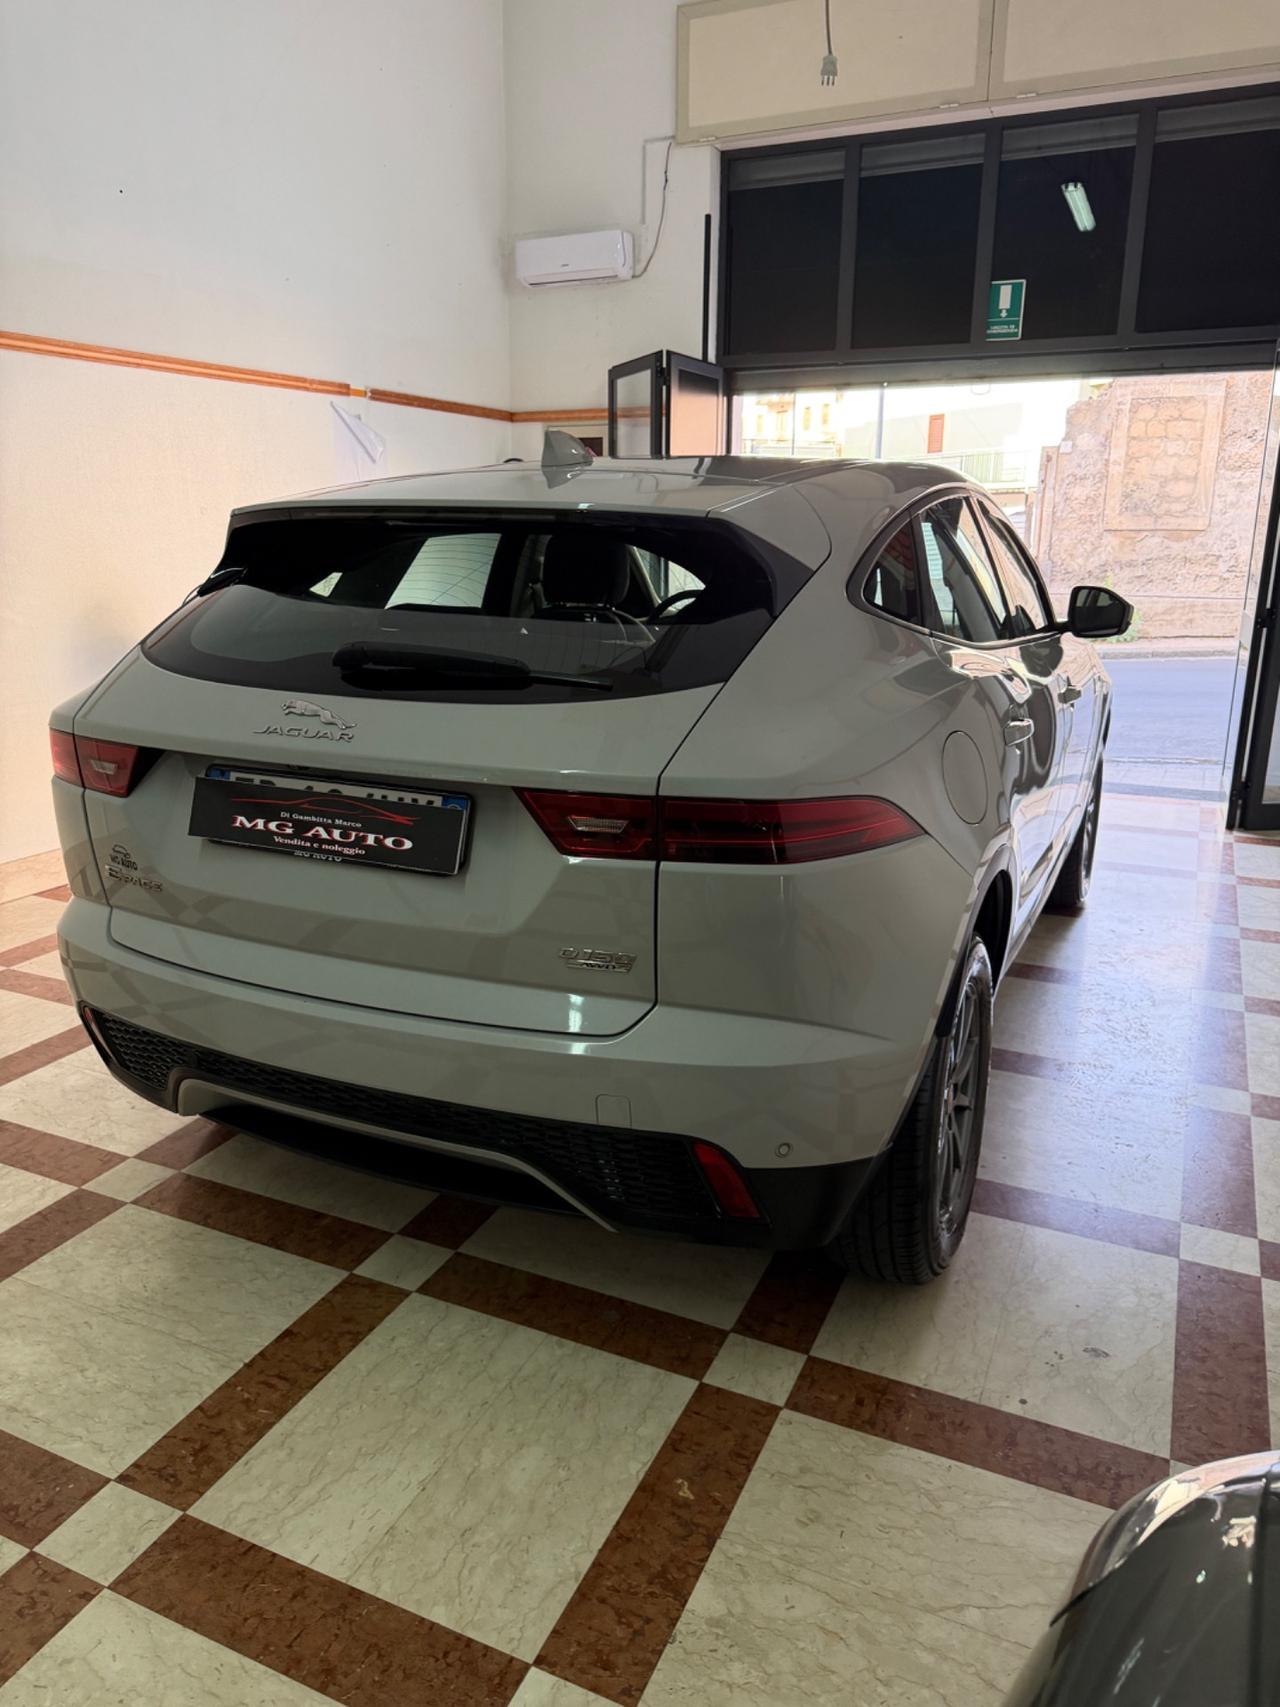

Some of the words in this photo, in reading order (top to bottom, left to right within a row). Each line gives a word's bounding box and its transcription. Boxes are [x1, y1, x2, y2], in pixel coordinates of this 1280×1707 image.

[253, 726, 355, 743] JAGUAR
[292, 813, 332, 824] Gambitta
[334, 818, 362, 828] Marco
[232, 815, 296, 834] MG
[301, 826, 413, 850] AUTO
[273, 836, 311, 847] Vendita
[322, 844, 366, 855] noleggio
